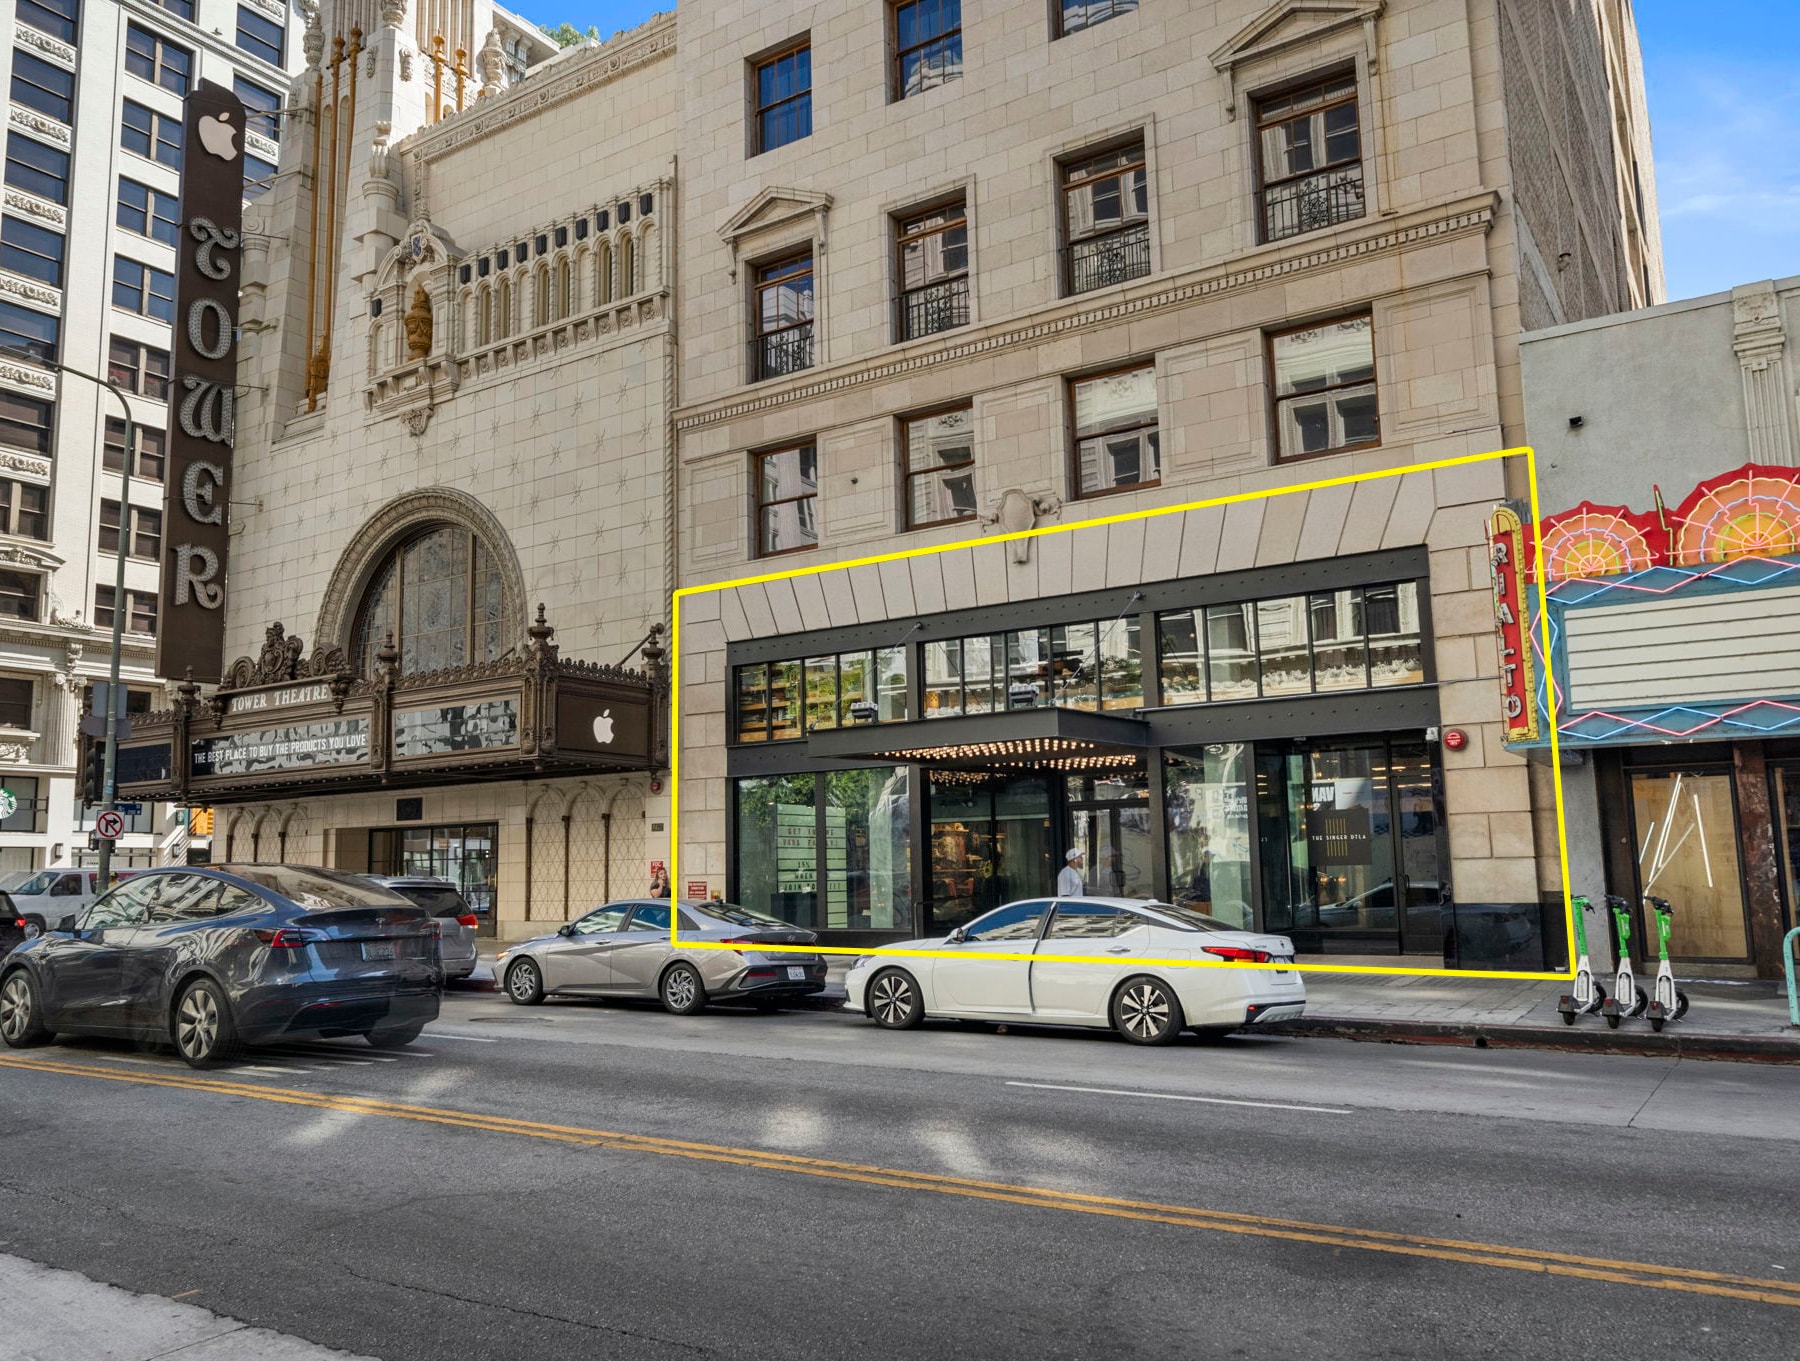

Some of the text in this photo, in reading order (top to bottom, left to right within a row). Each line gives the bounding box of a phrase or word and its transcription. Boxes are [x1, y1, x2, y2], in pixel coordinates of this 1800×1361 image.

[173, 215, 239, 609] TOWER
[1494, 542, 1522, 719] RIALTO
[231, 684, 329, 712] TOWER THEATRE
[194, 733, 366, 764] THE BEST PLACE TO BUY THE PRODUCTS YOU LOVE
[784, 883, 802, 891] JOIN
